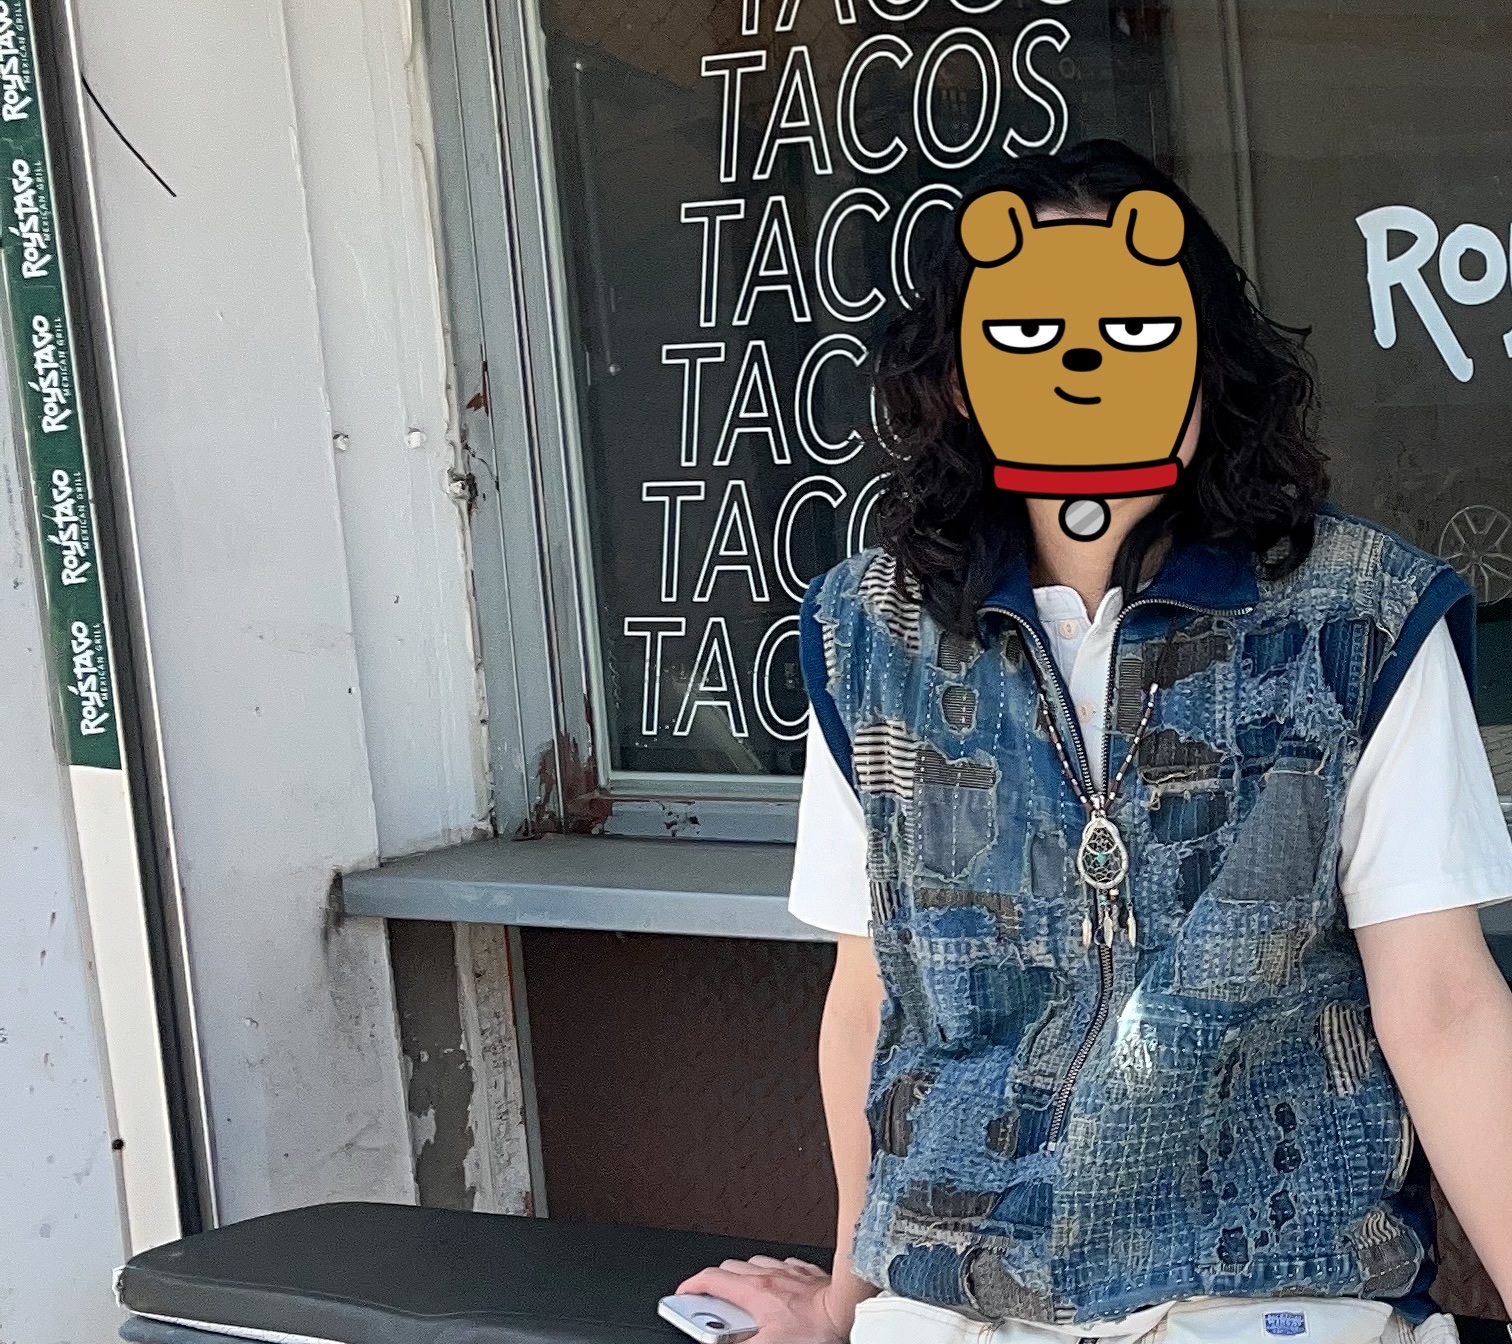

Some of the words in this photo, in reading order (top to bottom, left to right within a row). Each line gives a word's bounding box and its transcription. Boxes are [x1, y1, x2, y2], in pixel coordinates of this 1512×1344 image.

[700, 17, 1072, 184] TACOS
[680, 183, 964, 329] TAC
[661, 332, 912, 468] TAC
[641, 471, 892, 603] TAC
